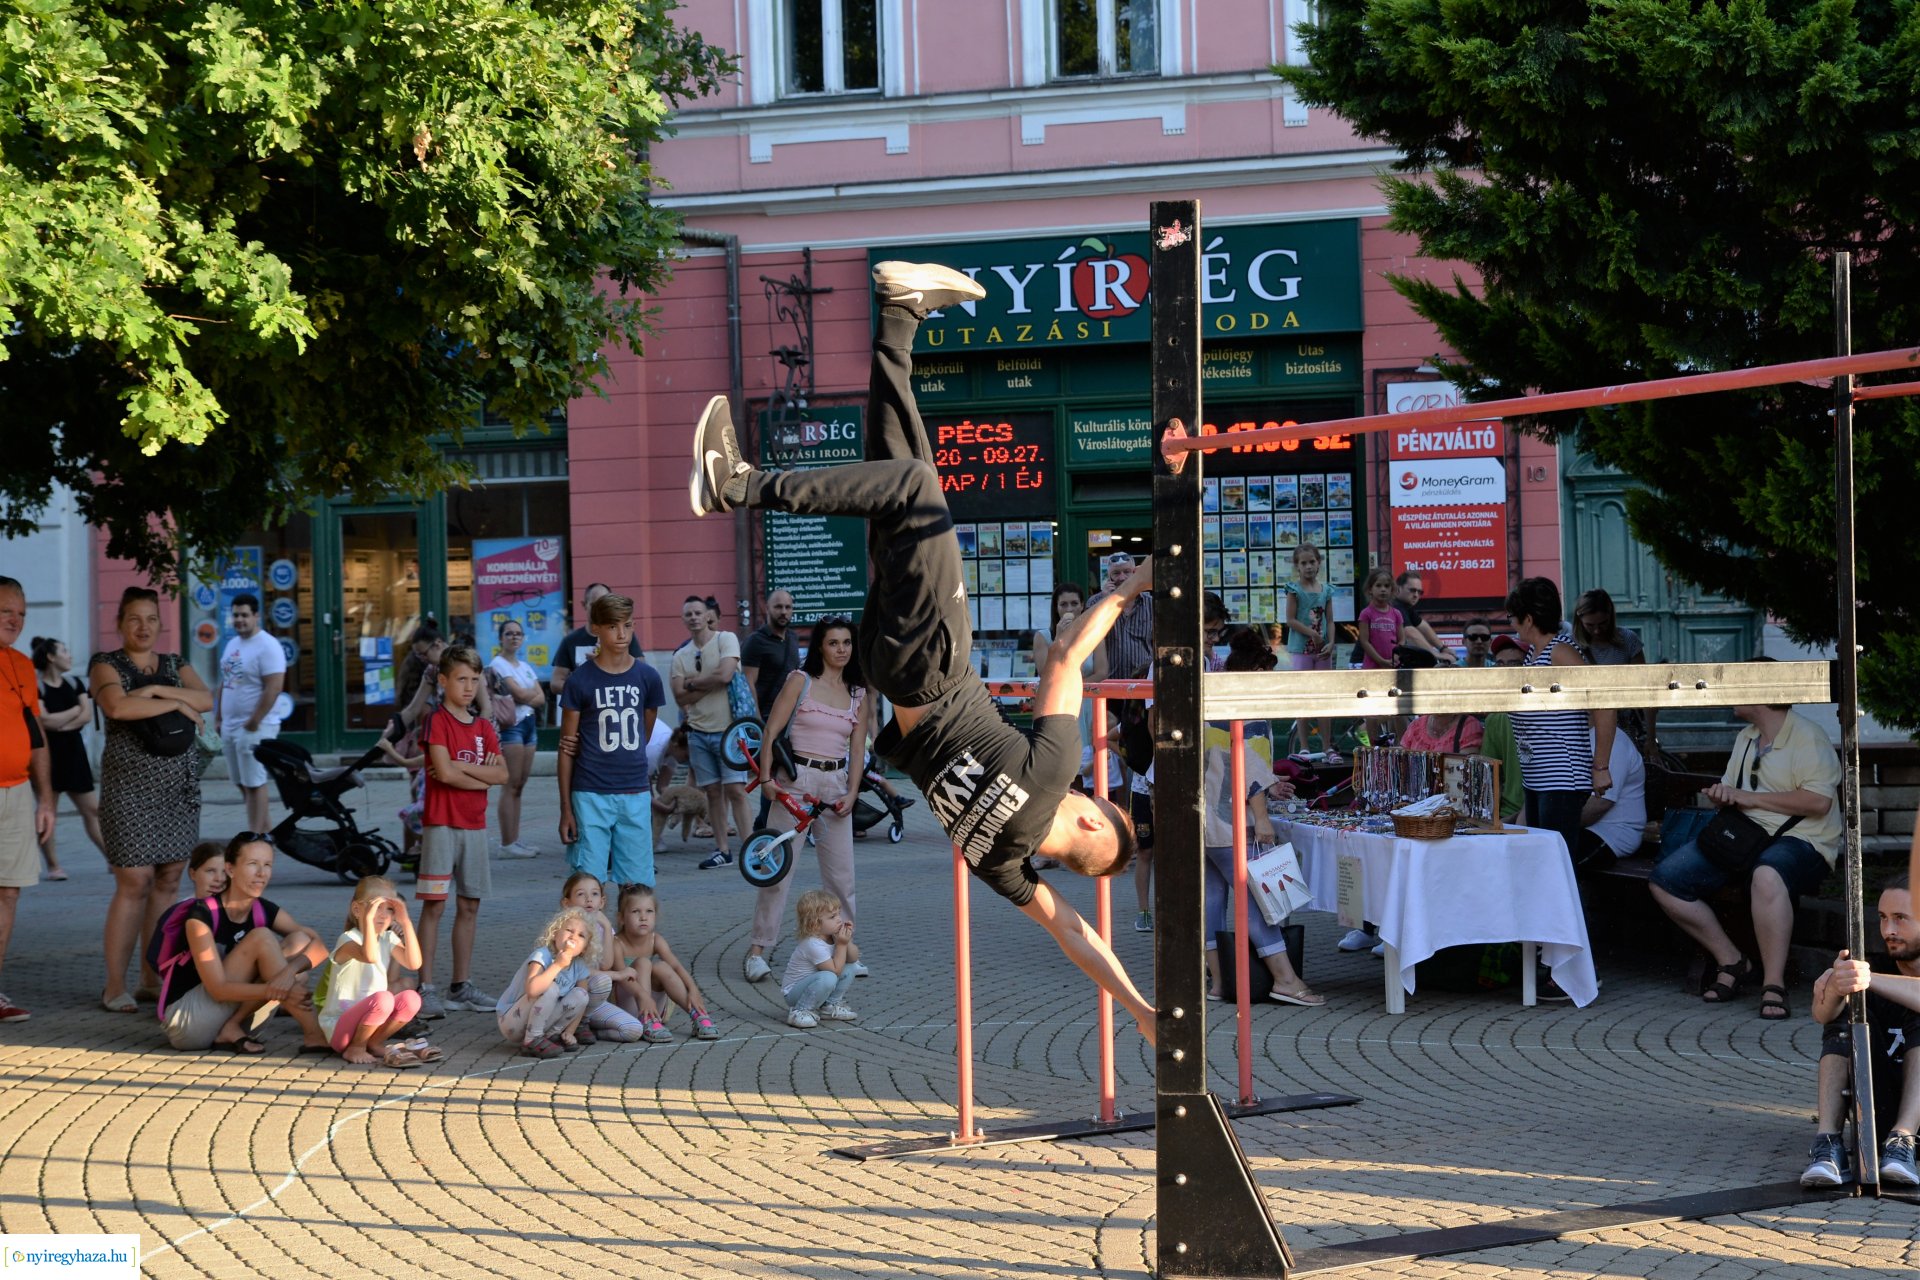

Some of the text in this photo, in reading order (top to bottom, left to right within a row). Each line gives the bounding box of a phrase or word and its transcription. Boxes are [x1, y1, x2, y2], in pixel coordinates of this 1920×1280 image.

[927, 236, 1302, 319] YÍRÉG
[926, 311, 1300, 347] UTAZÁSI ODA
[1201, 349, 1254, 364] pülőjegy
[1297, 345, 1325, 357] Utas
[911, 360, 964, 379] lágkörüli
[996, 358, 1042, 372] Belföldi
[1201, 364, 1252, 379] tékesítés
[1285, 360, 1342, 375] biztosítás
[920, 379, 946, 393] utak
[1006, 375, 1033, 389] utak
[1395, 388, 1462, 413] CORN
[937, 420, 1014, 445] PÉCS
[1074, 419, 1127, 434] Kulturális
[1397, 425, 1496, 453] PÉNZVÁLTÓ
[819, 448, 857, 458] IRODA
[983, 445, 1045, 465] 09.27.
[1016, 465, 1043, 489] ÉJ
[1527, 466, 1547, 482] 10
[1421, 475, 1496, 489] MoneyGram
[1421, 489, 1462, 498] pénzküldés
[1398, 511, 1499, 522] KÉSZPÉNZ ÁTUTALÁS AZONNAL
[1411, 521, 1431, 530] VILÁG
[1431, 520, 1457, 529] MINDEN
[1458, 518, 1493, 528] PONTJÁRA
[1403, 538, 1495, 550] BANKKÁRTYÁS PÉNZVÁLTÁS
[486, 560, 548, 573] KOMBINÁLJA
[1405, 560, 1425, 571] Tel.:
[1425, 560, 1439, 571] 06
[1440, 560, 1452, 570] 42
[1460, 559, 1479, 570] 386
[1480, 558, 1495, 569] 221
[477, 573, 558, 585] KEDVEZMÉNYÉT!
[595, 684, 640, 709] LET'S
[598, 707, 640, 753] GO
